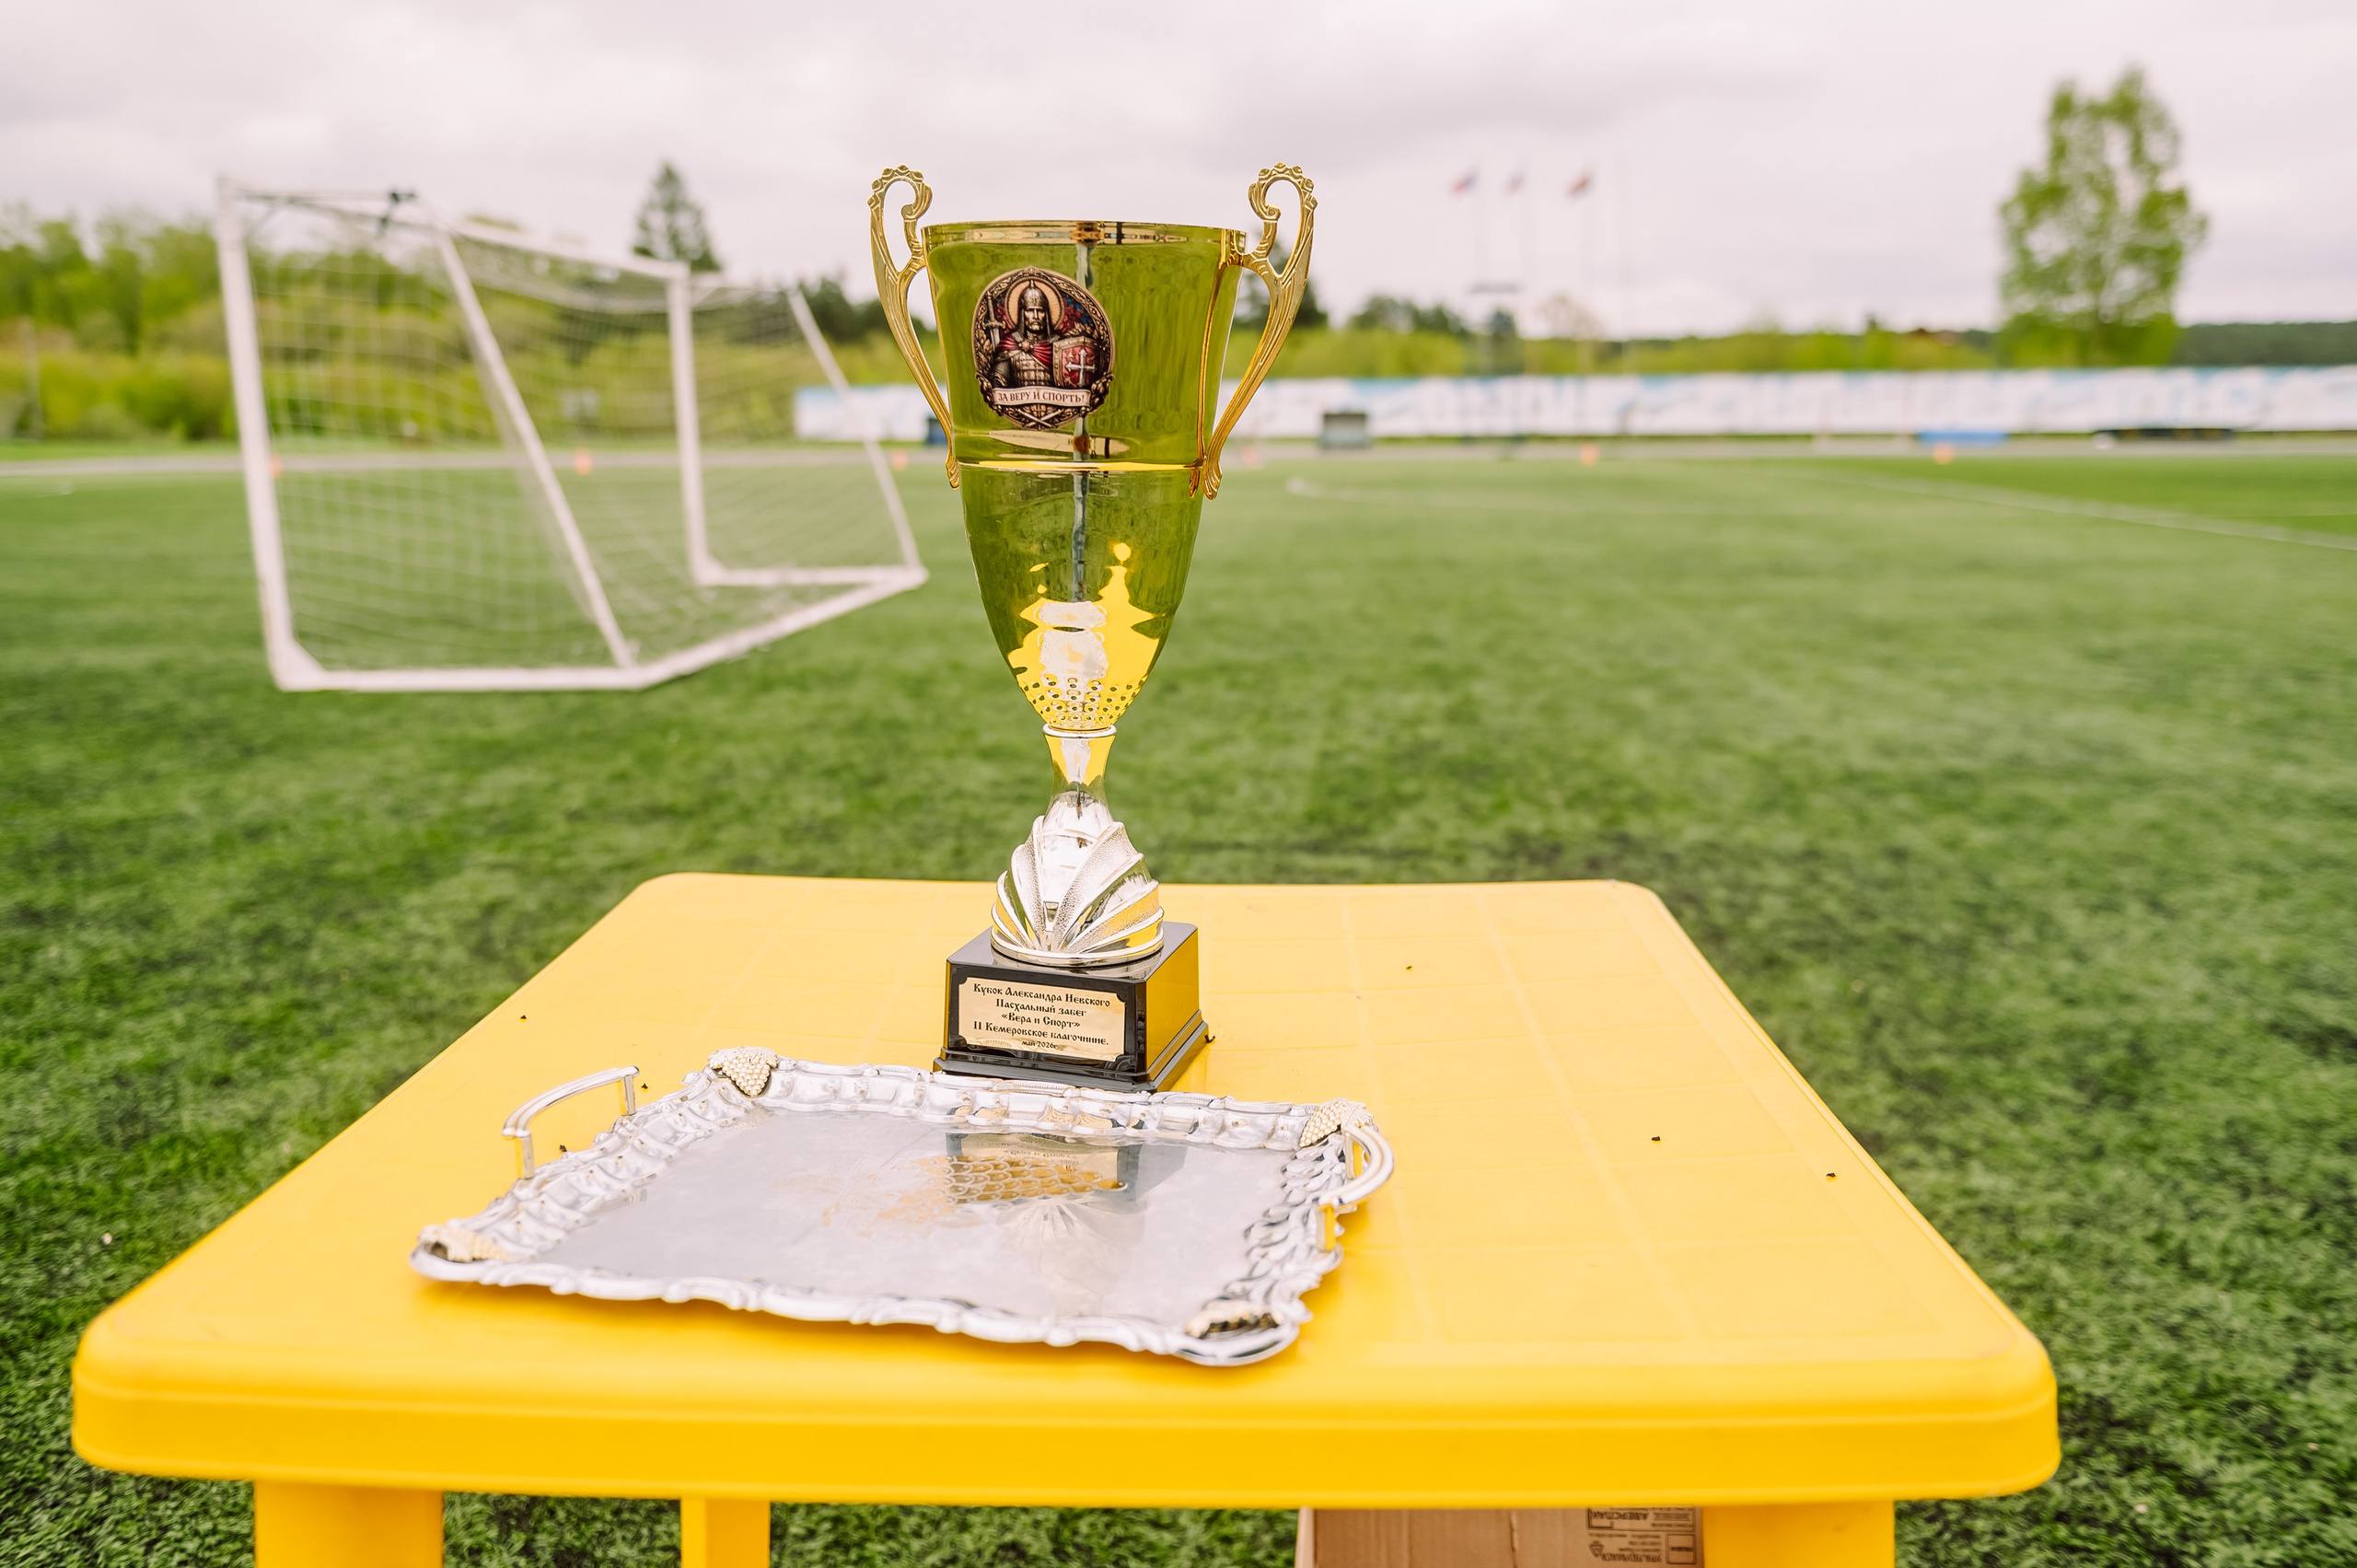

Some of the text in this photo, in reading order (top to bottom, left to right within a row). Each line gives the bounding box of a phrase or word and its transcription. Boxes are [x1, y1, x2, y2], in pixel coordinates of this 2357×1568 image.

[998, 393, 1008, 401] ЗА
[1010, 391, 1031, 401] ВЕРУ
[1033, 391, 1040, 400] И
[973, 983, 1110, 1007] Кубок Александра Невского
[996, 998, 1086, 1016] Пасхальный забег
[1002, 1012, 1032, 1025] «Вера
[1043, 1016, 1081, 1029] Спорт»
[985, 1022, 1048, 1038] Кемеровское
